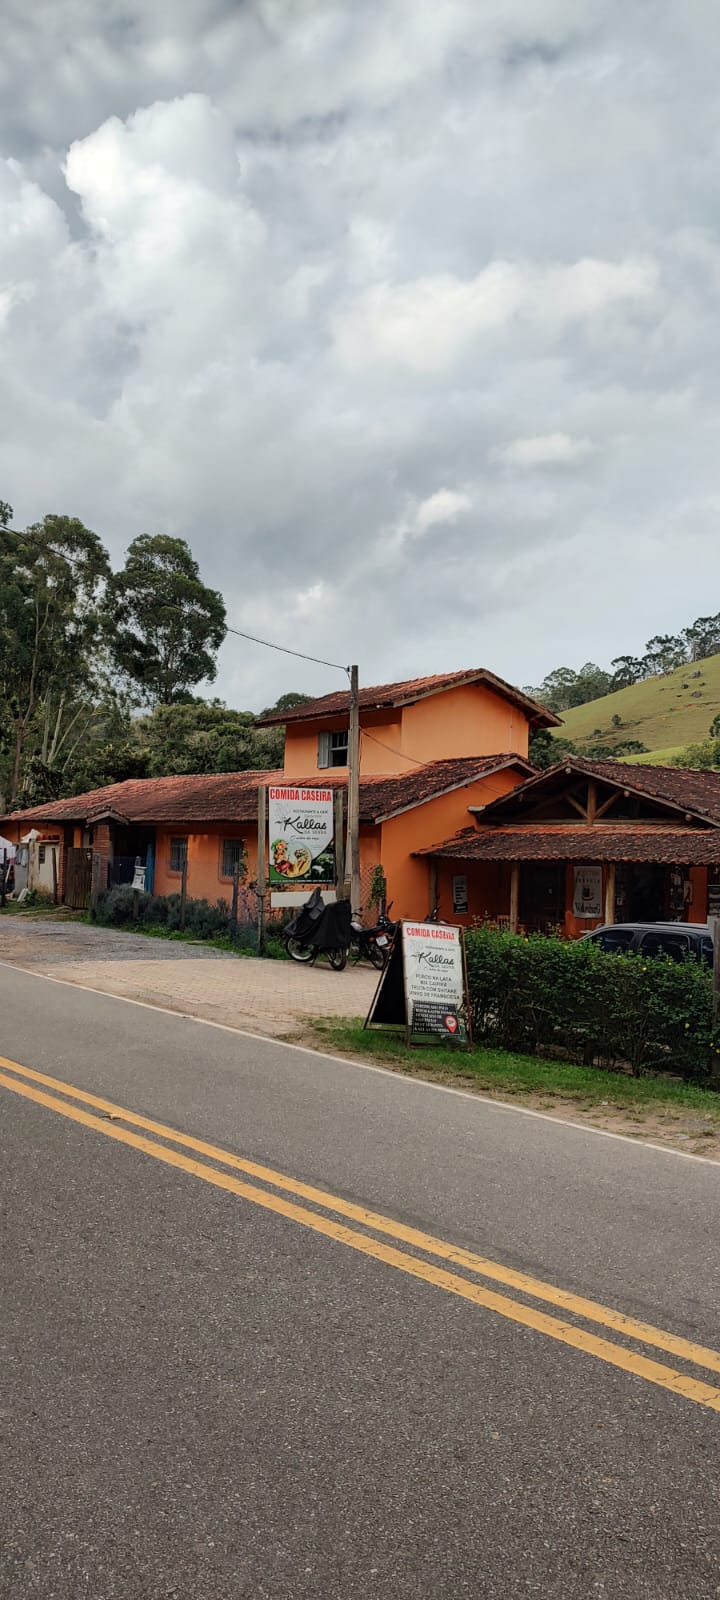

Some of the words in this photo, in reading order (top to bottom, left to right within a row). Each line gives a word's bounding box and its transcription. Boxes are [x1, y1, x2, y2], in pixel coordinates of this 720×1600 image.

[270, 789, 299, 800] COMIDA
[301, 790, 332, 801] CASEIRA
[283, 815, 327, 834] Kallas
[406, 927, 430, 938] COMIDA
[418, 951, 455, 968] Kallas
